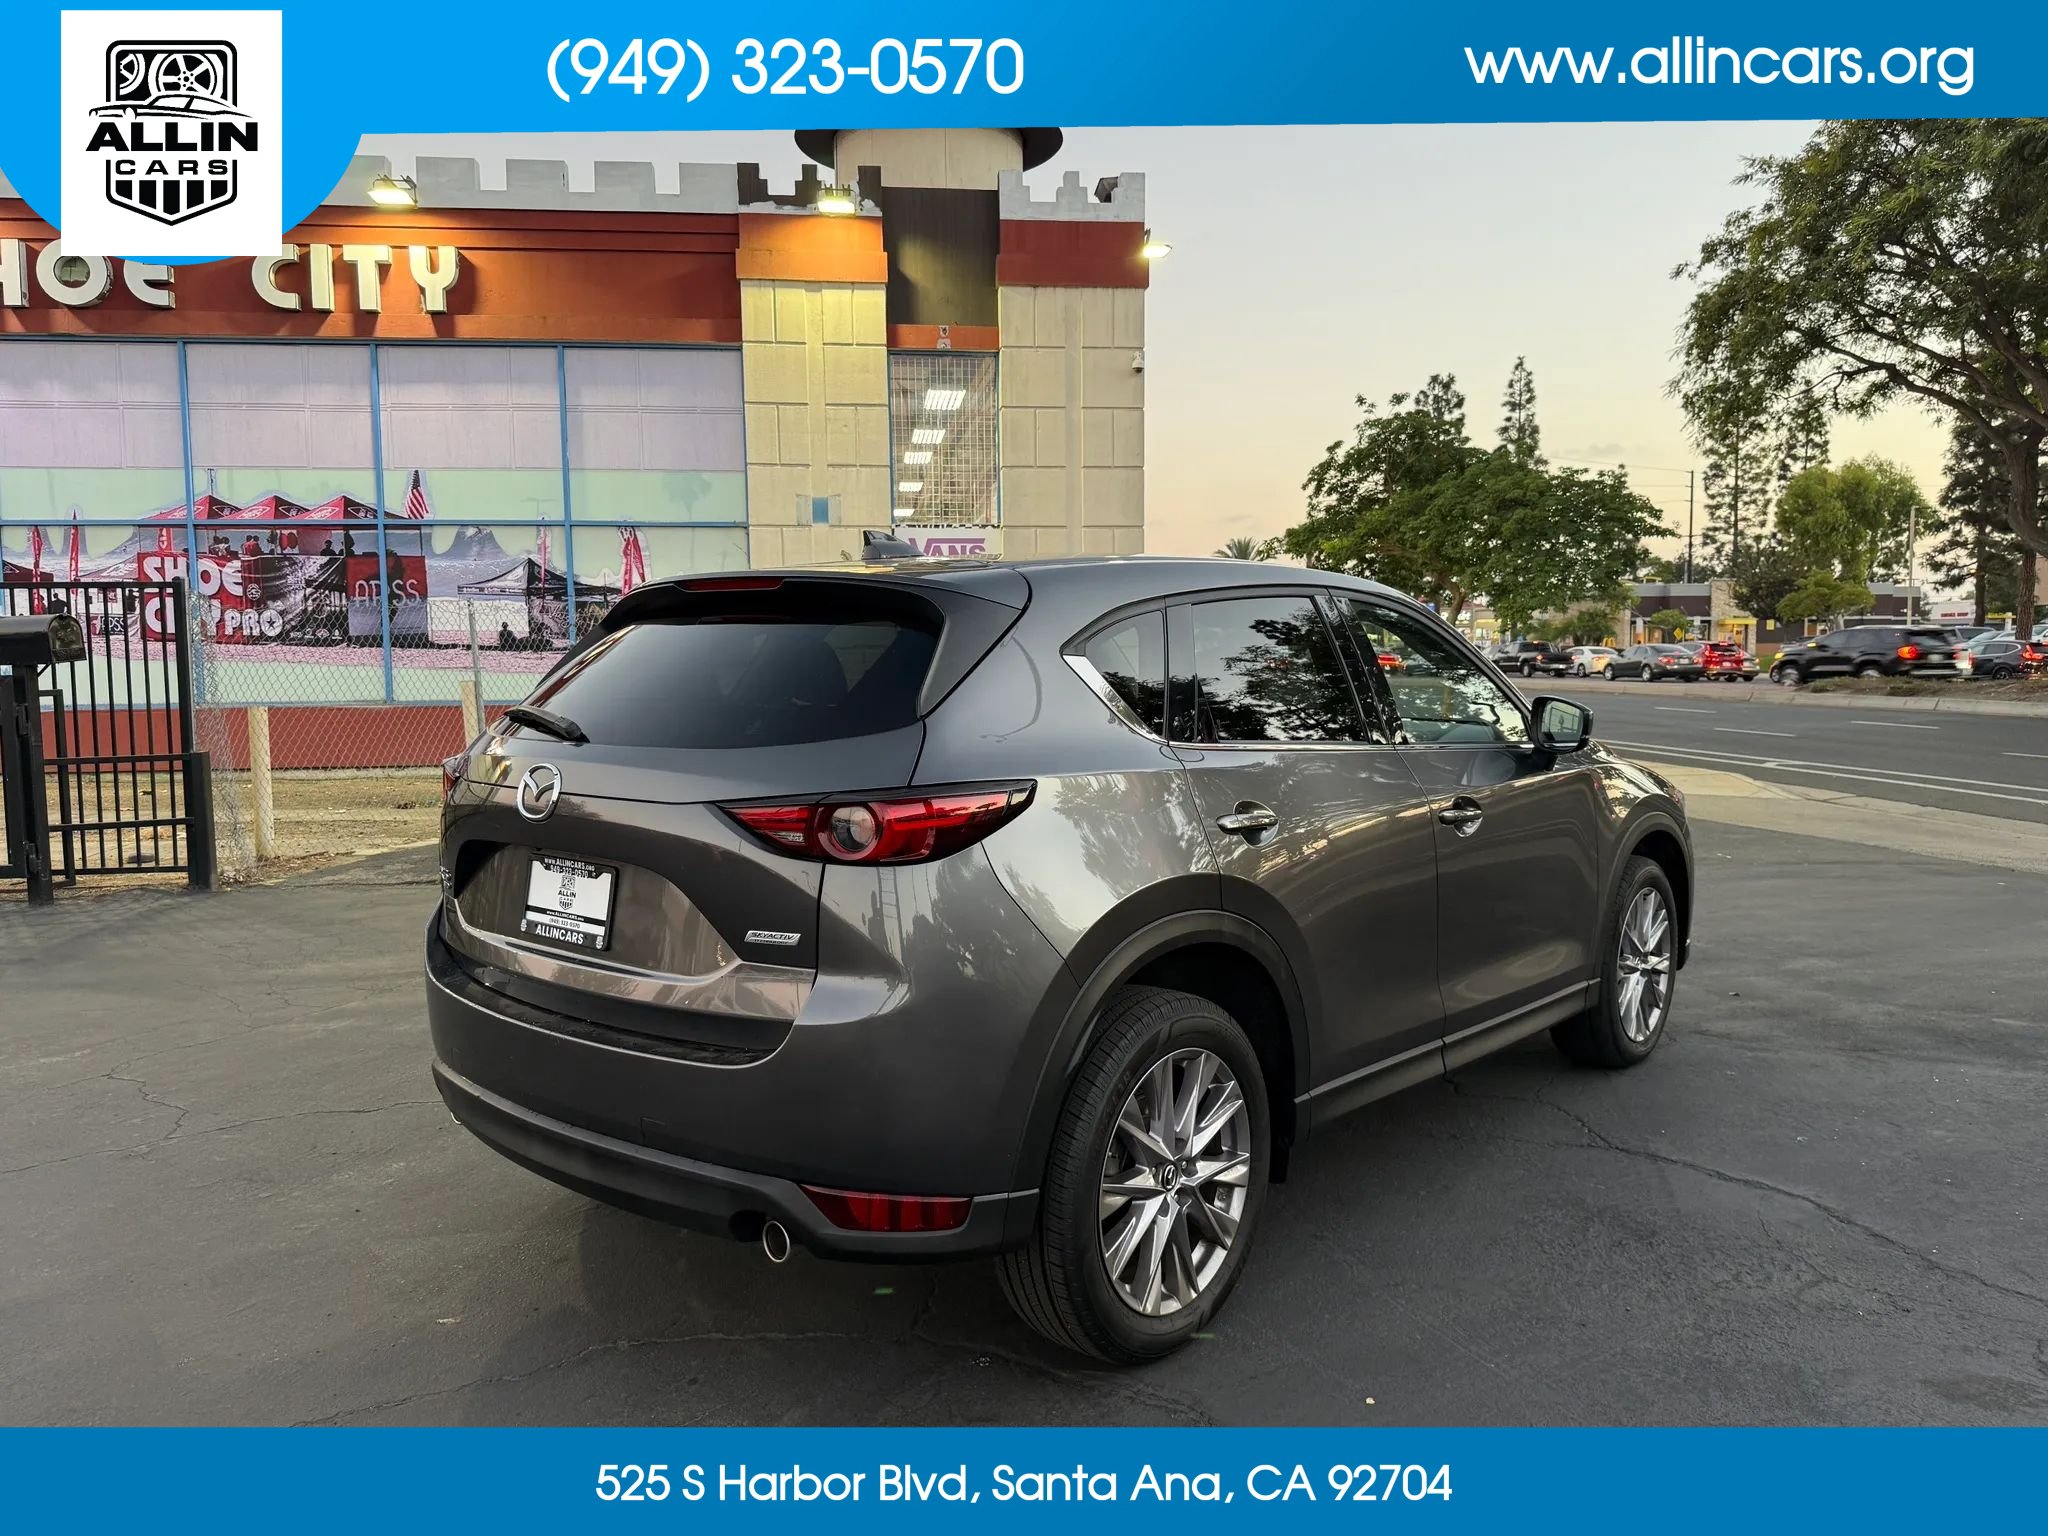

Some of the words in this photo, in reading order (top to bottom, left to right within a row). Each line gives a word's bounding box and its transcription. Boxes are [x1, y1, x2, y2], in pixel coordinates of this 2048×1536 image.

[252, 243, 459, 313] CITY
[143, 556, 244, 597] SHOE
[558, 889, 576, 898] ALLIN
[535, 924, 584, 944] ALLINCARS
[751, 932, 794, 940] SKYACTIV
